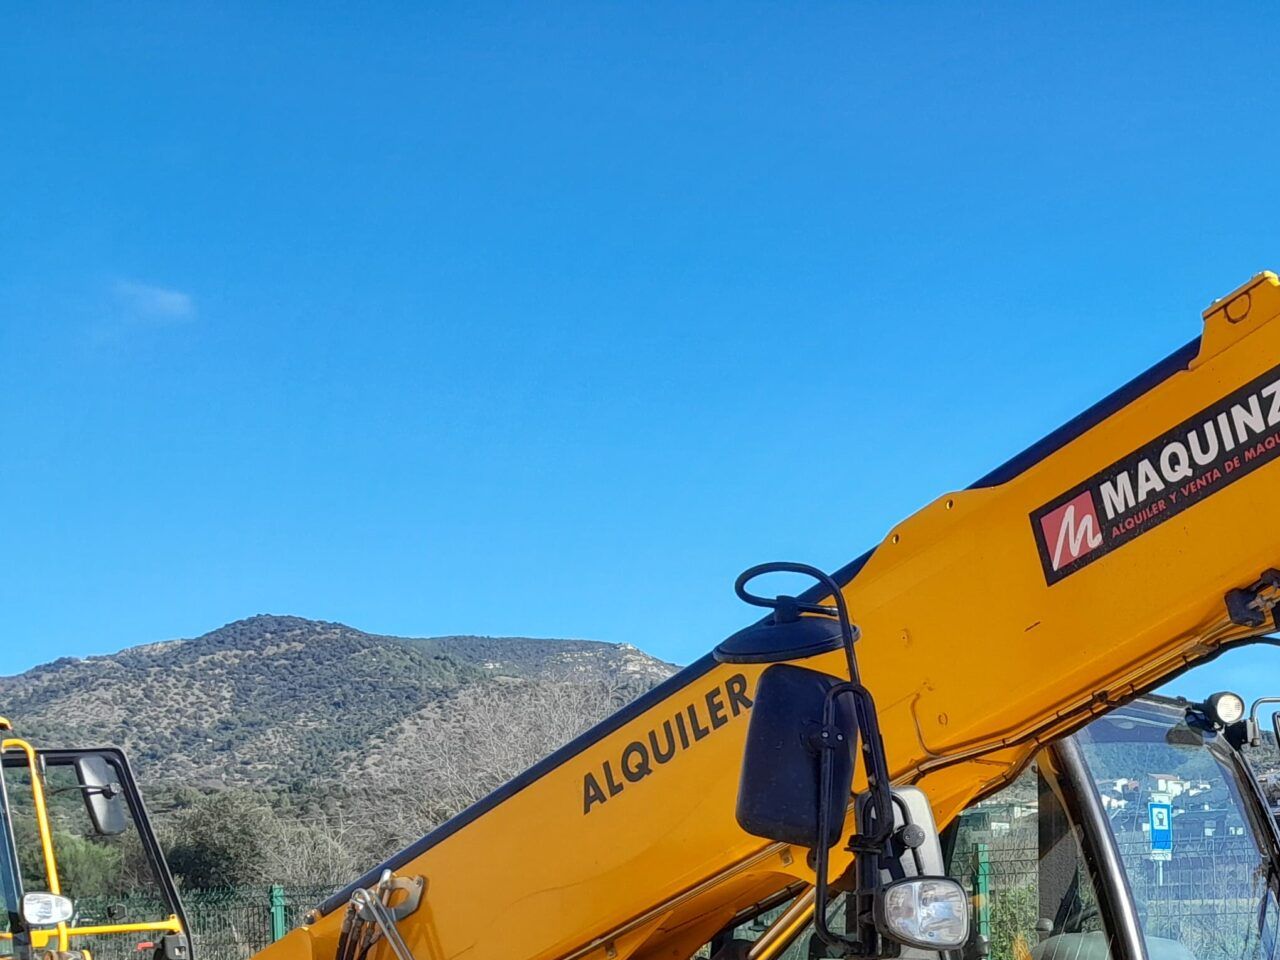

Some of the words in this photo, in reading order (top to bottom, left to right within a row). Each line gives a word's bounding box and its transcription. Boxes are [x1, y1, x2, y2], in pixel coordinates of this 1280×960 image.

[1111, 499, 1167, 538] ALQUILER
[1168, 491, 1179, 504] Y
[1181, 467, 1223, 498] VENTA
[1224, 455, 1241, 473] DE
[583, 672, 753, 816] ALQUILER
